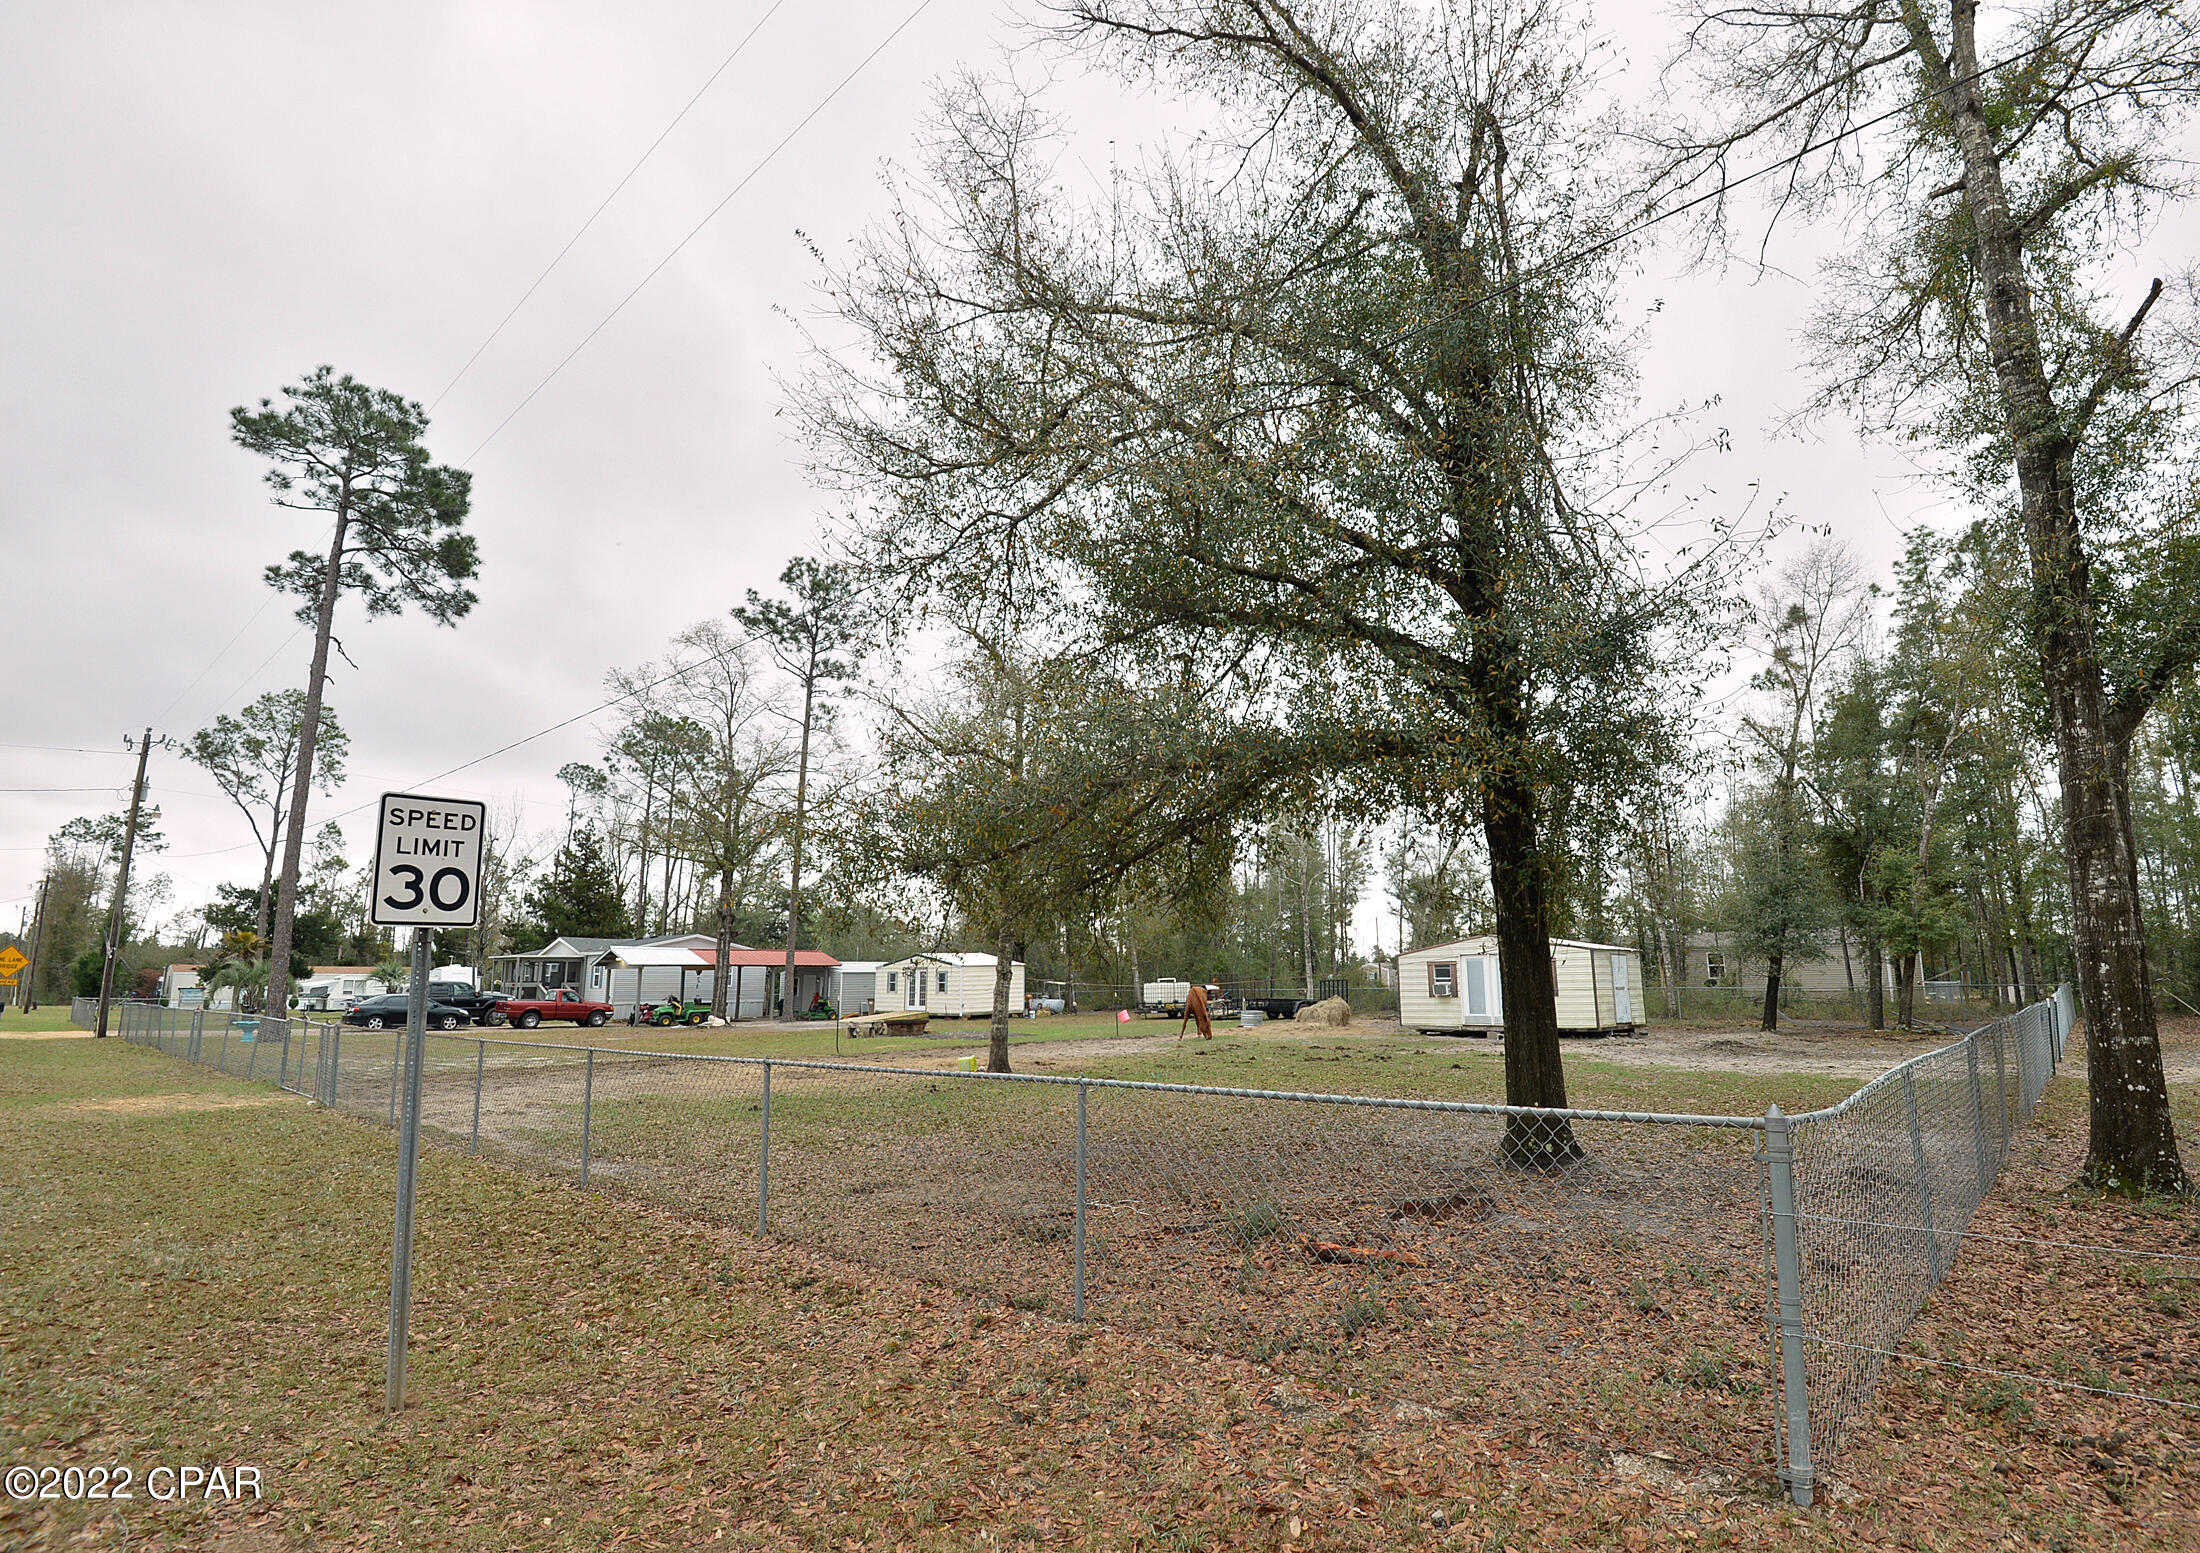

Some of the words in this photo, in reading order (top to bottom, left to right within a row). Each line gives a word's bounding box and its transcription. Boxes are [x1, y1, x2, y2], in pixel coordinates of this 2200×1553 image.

[389, 808, 477, 832] SPEED
[396, 836, 465, 858] LIMIT
[383, 864, 470, 912] 30
